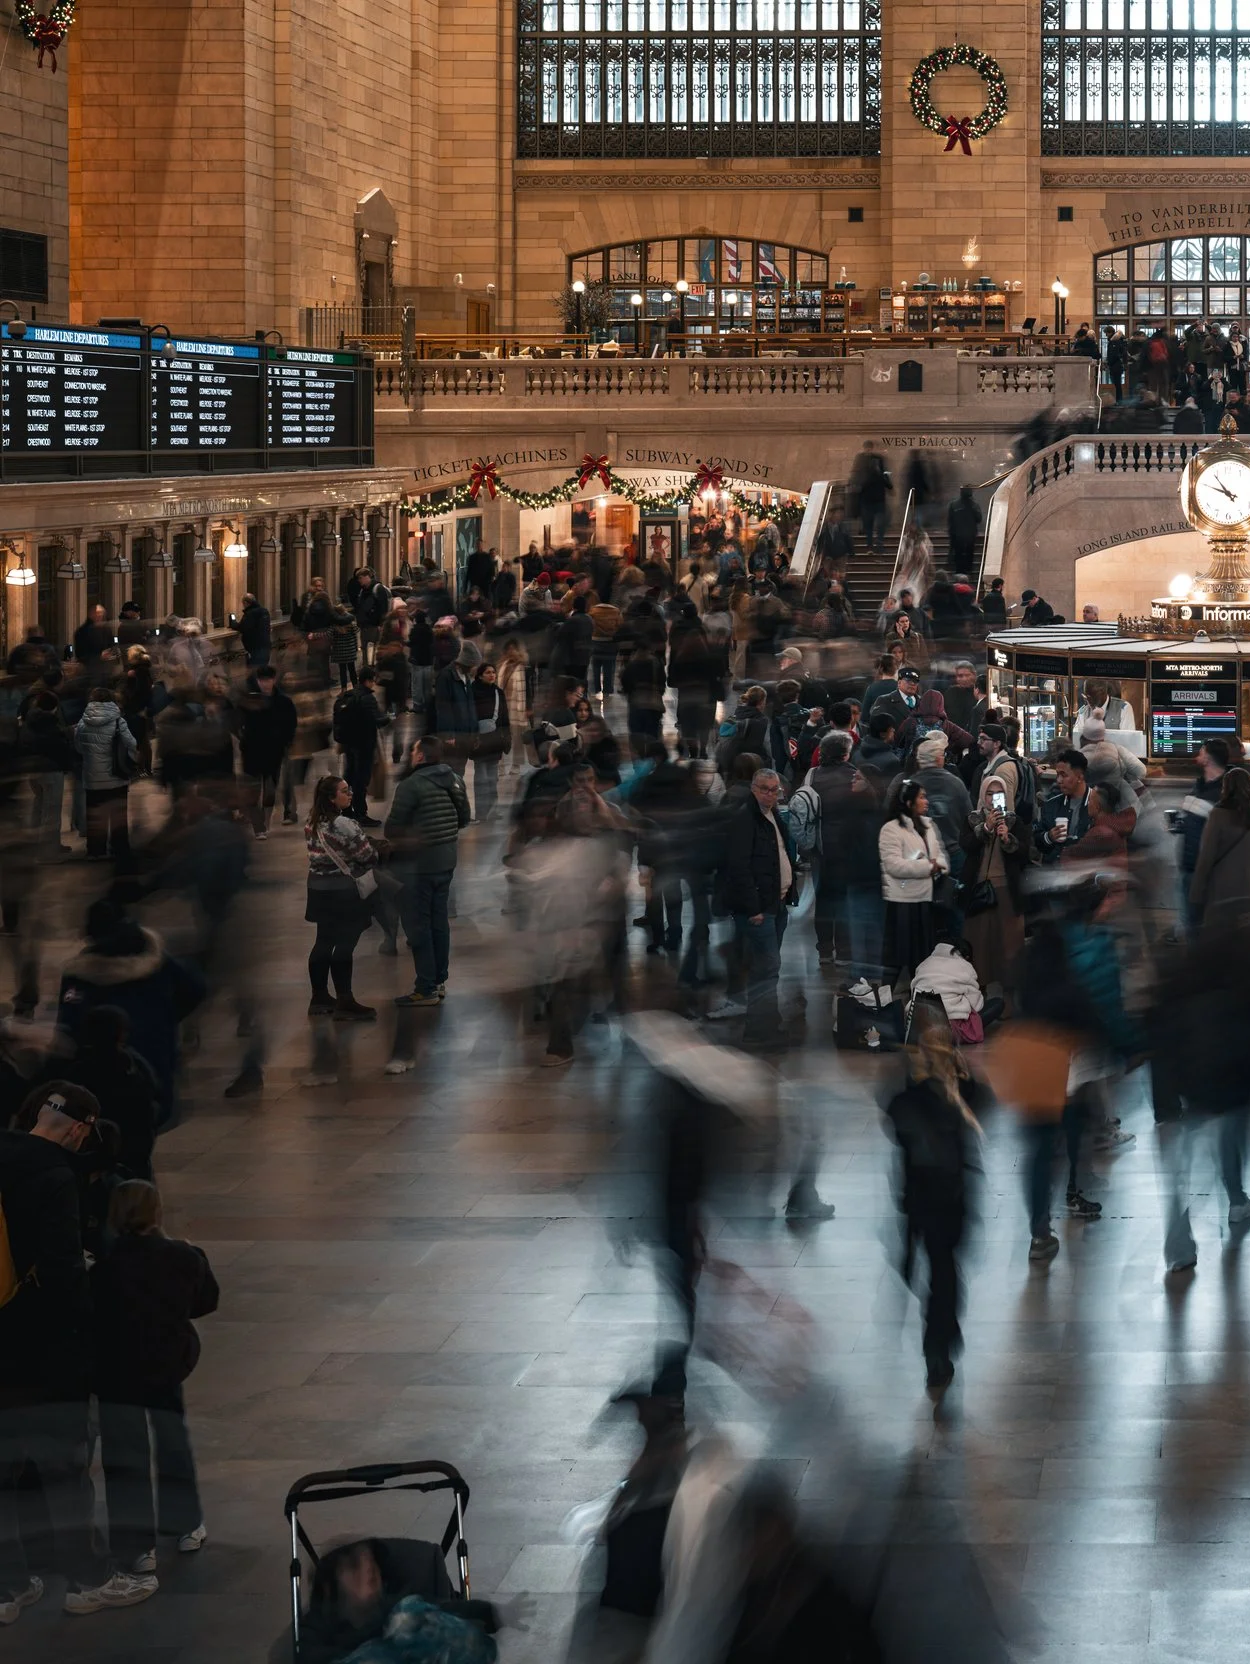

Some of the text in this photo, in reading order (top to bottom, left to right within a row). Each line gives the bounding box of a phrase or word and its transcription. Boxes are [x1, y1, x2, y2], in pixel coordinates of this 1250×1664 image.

[1121, 211, 1143, 225] TO
[1108, 226, 1142, 243] THE
[1151, 217, 1235, 234] CAMPBELL
[691, 285, 705, 294] EXIT
[35, 329, 109, 346] HARLEM LINE DEPARTURES
[881, 437, 976, 447] WEST BALCONY
[413, 448, 568, 482] TICKET MACHINES
[625, 449, 773, 478] SUBWAY 42ND ST
[1077, 538, 1108, 555] LONG
[1110, 527, 1148, 545] ISLAND
[1151, 523, 1176, 534] RAIL
[1173, 692, 1215, 700] ARRIVALS
